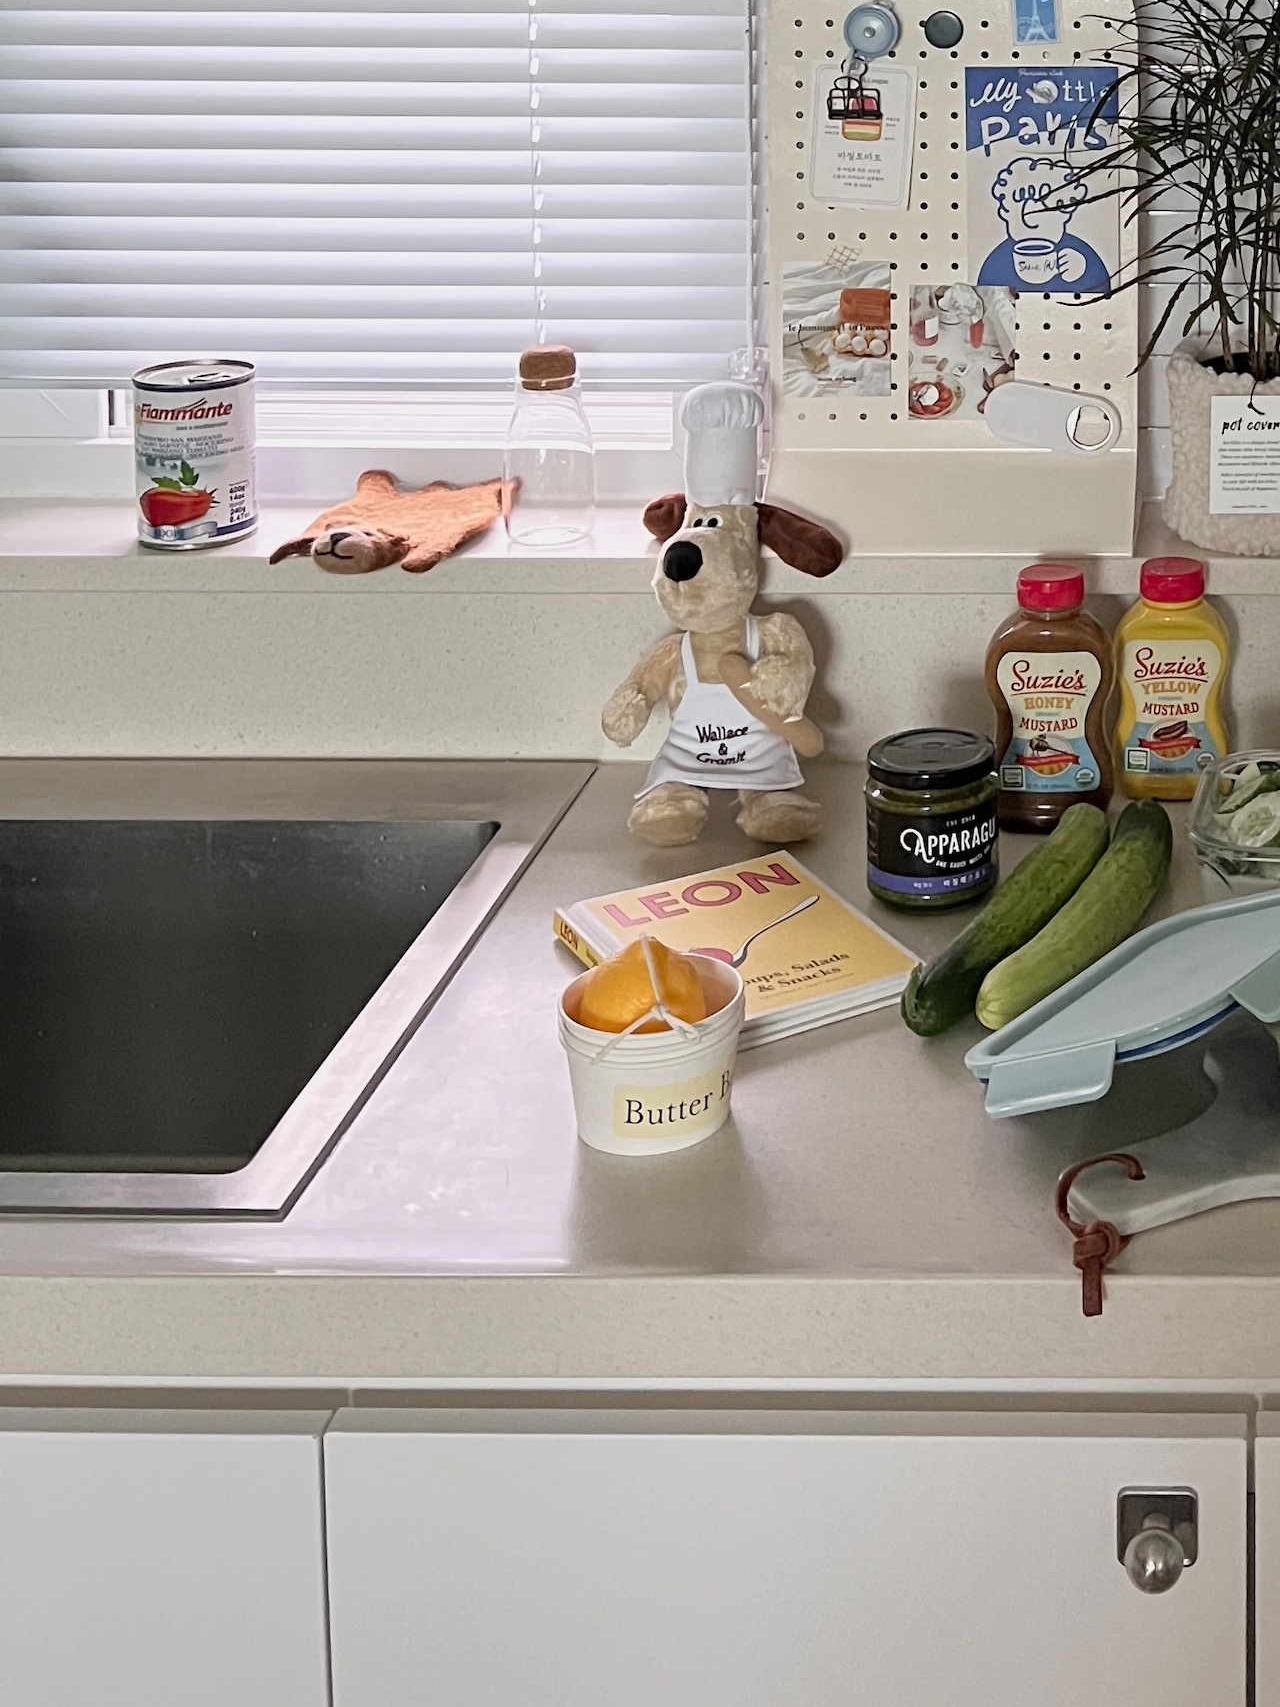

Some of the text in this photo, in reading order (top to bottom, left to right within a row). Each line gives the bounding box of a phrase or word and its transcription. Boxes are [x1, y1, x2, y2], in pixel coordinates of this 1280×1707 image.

[980, 110, 1108, 158] Paris
[141, 401, 233, 421] Fiammante
[1221, 417, 1280, 435] pot cover
[1133, 647, 1208, 679] Suzie's
[1010, 659, 1087, 692] Suzie's
[1141, 681, 1201, 695] YELLOW
[1024, 696, 1076, 710] HONEY
[1142, 702, 1200, 716] MUSTARD
[695, 723, 749, 743] Wallace
[1019, 717, 1078, 732] MUSTARD
[696, 750, 746, 765] Gromit
[718, 742, 728, 755] &
[602, 862, 801, 929] LEON
[791, 953, 851, 973] Salads
[757, 984, 776, 993] &
[777, 967, 842, 987] Snacks
[624, 1091, 714, 1126] Butter
